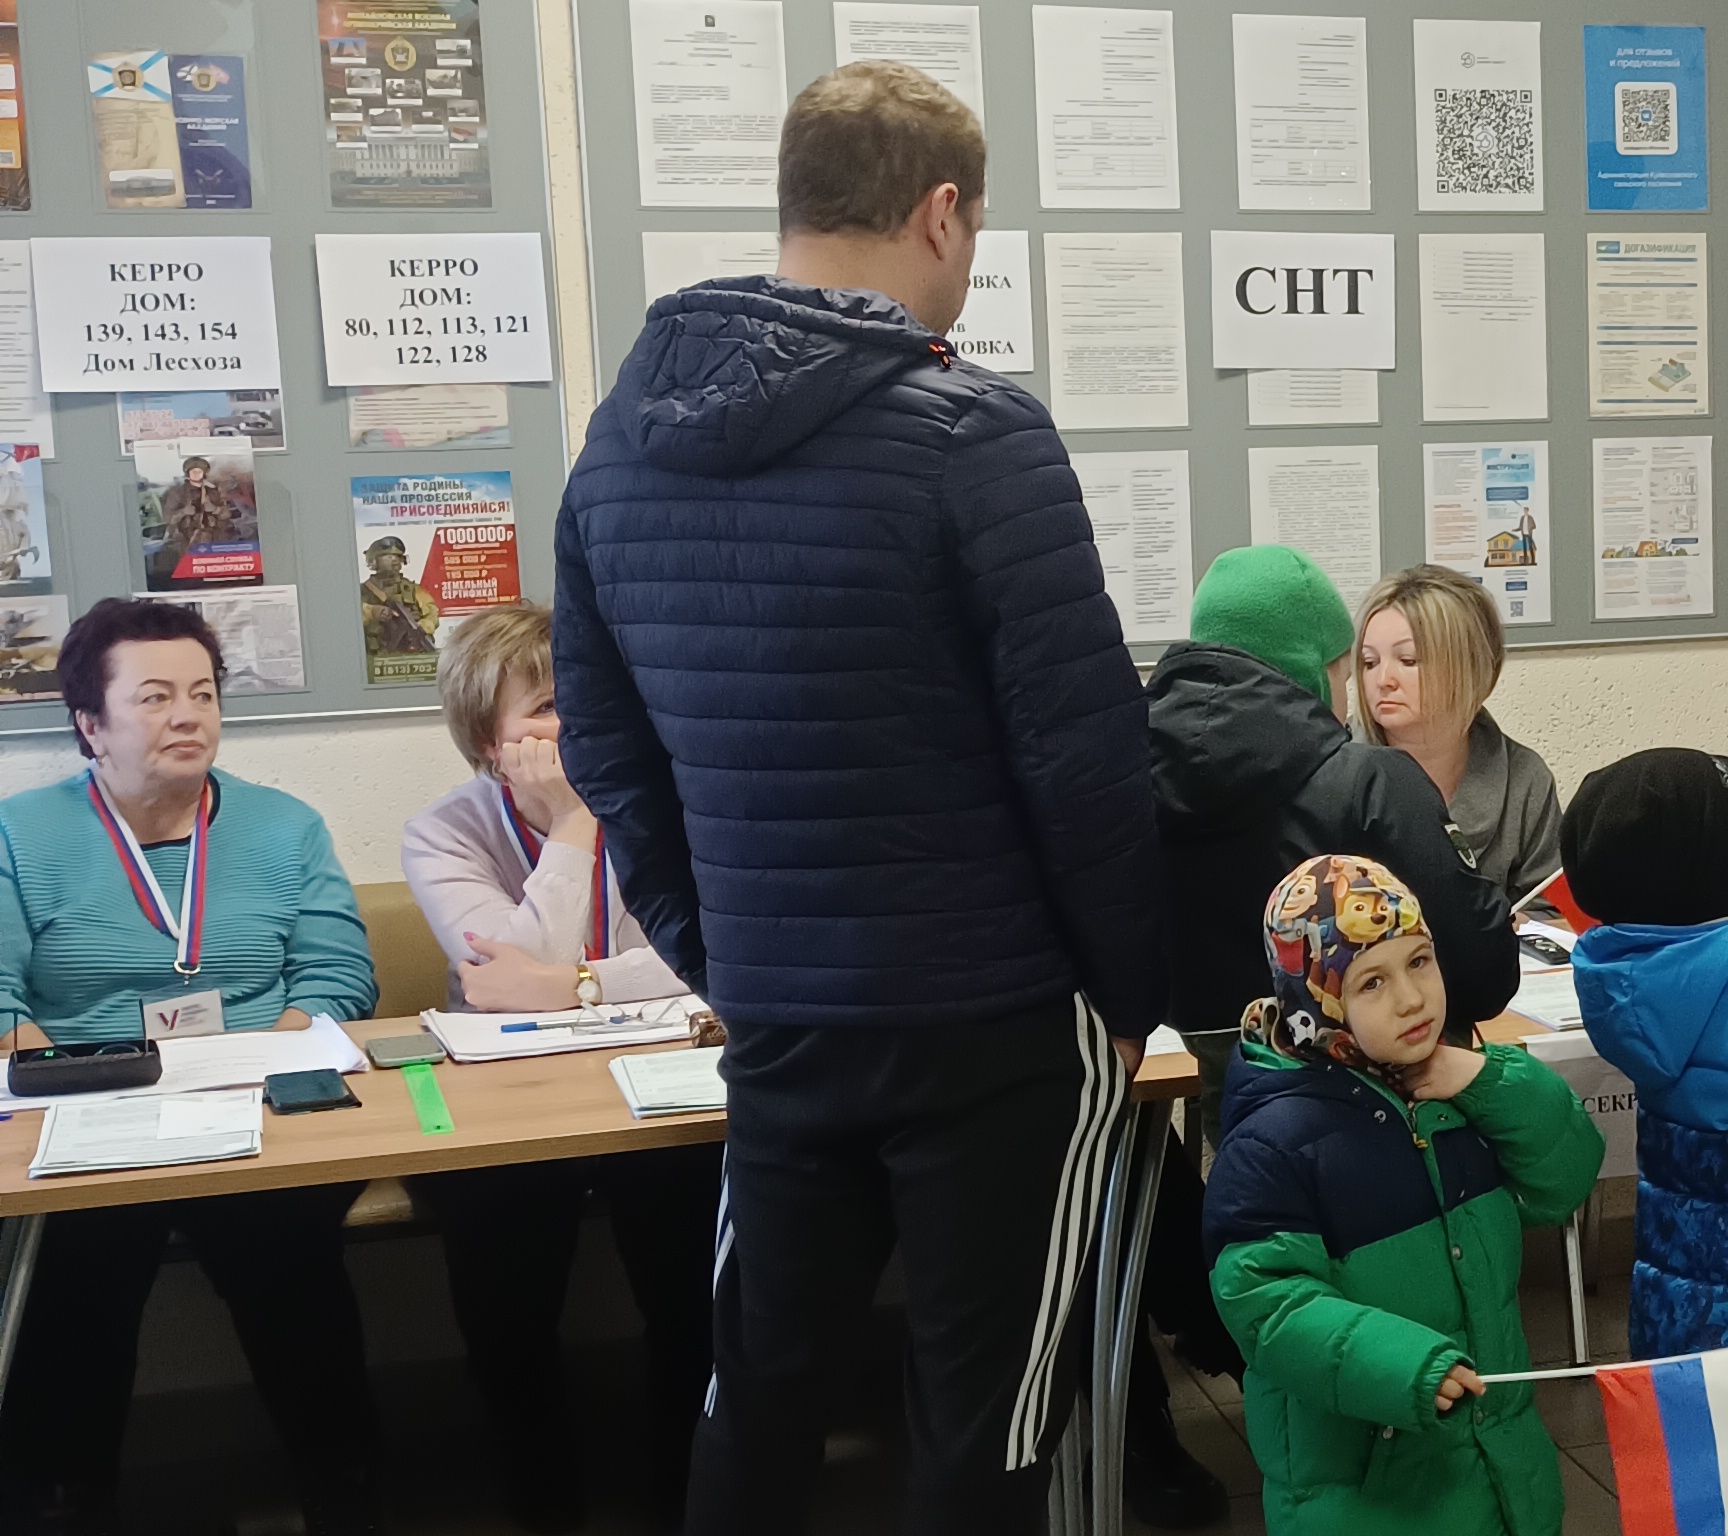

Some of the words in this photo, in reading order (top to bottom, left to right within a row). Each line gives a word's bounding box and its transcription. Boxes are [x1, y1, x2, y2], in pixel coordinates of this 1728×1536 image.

[109, 262, 204, 283] КЕРРО
[388, 257, 479, 278] КЕРРО
[399, 287, 473, 310] ДОМ:
[1235, 266, 1374, 315] СНТ
[119, 292, 197, 316] ДОМ:
[83, 323, 133, 345] 139,
[141, 322, 190, 345] 143,
[198, 322, 238, 342] 154
[344, 318, 379, 340] 80,
[387, 317, 432, 338] 112,
[441, 315, 486, 337] 113,
[493, 315, 531, 333] 121
[82, 353, 136, 376] Дом
[143, 352, 243, 373] Лесхоза
[396, 345, 442, 368] 122,
[449, 344, 488, 364] 128
[412, 479, 463, 492] РОДИНЫ
[362, 493, 398, 505] НАША
[400, 491, 473, 504] ПРОФЕССИЯ
[390, 500, 511, 518] ПРИСОЕДИНЯЙСЯ!
